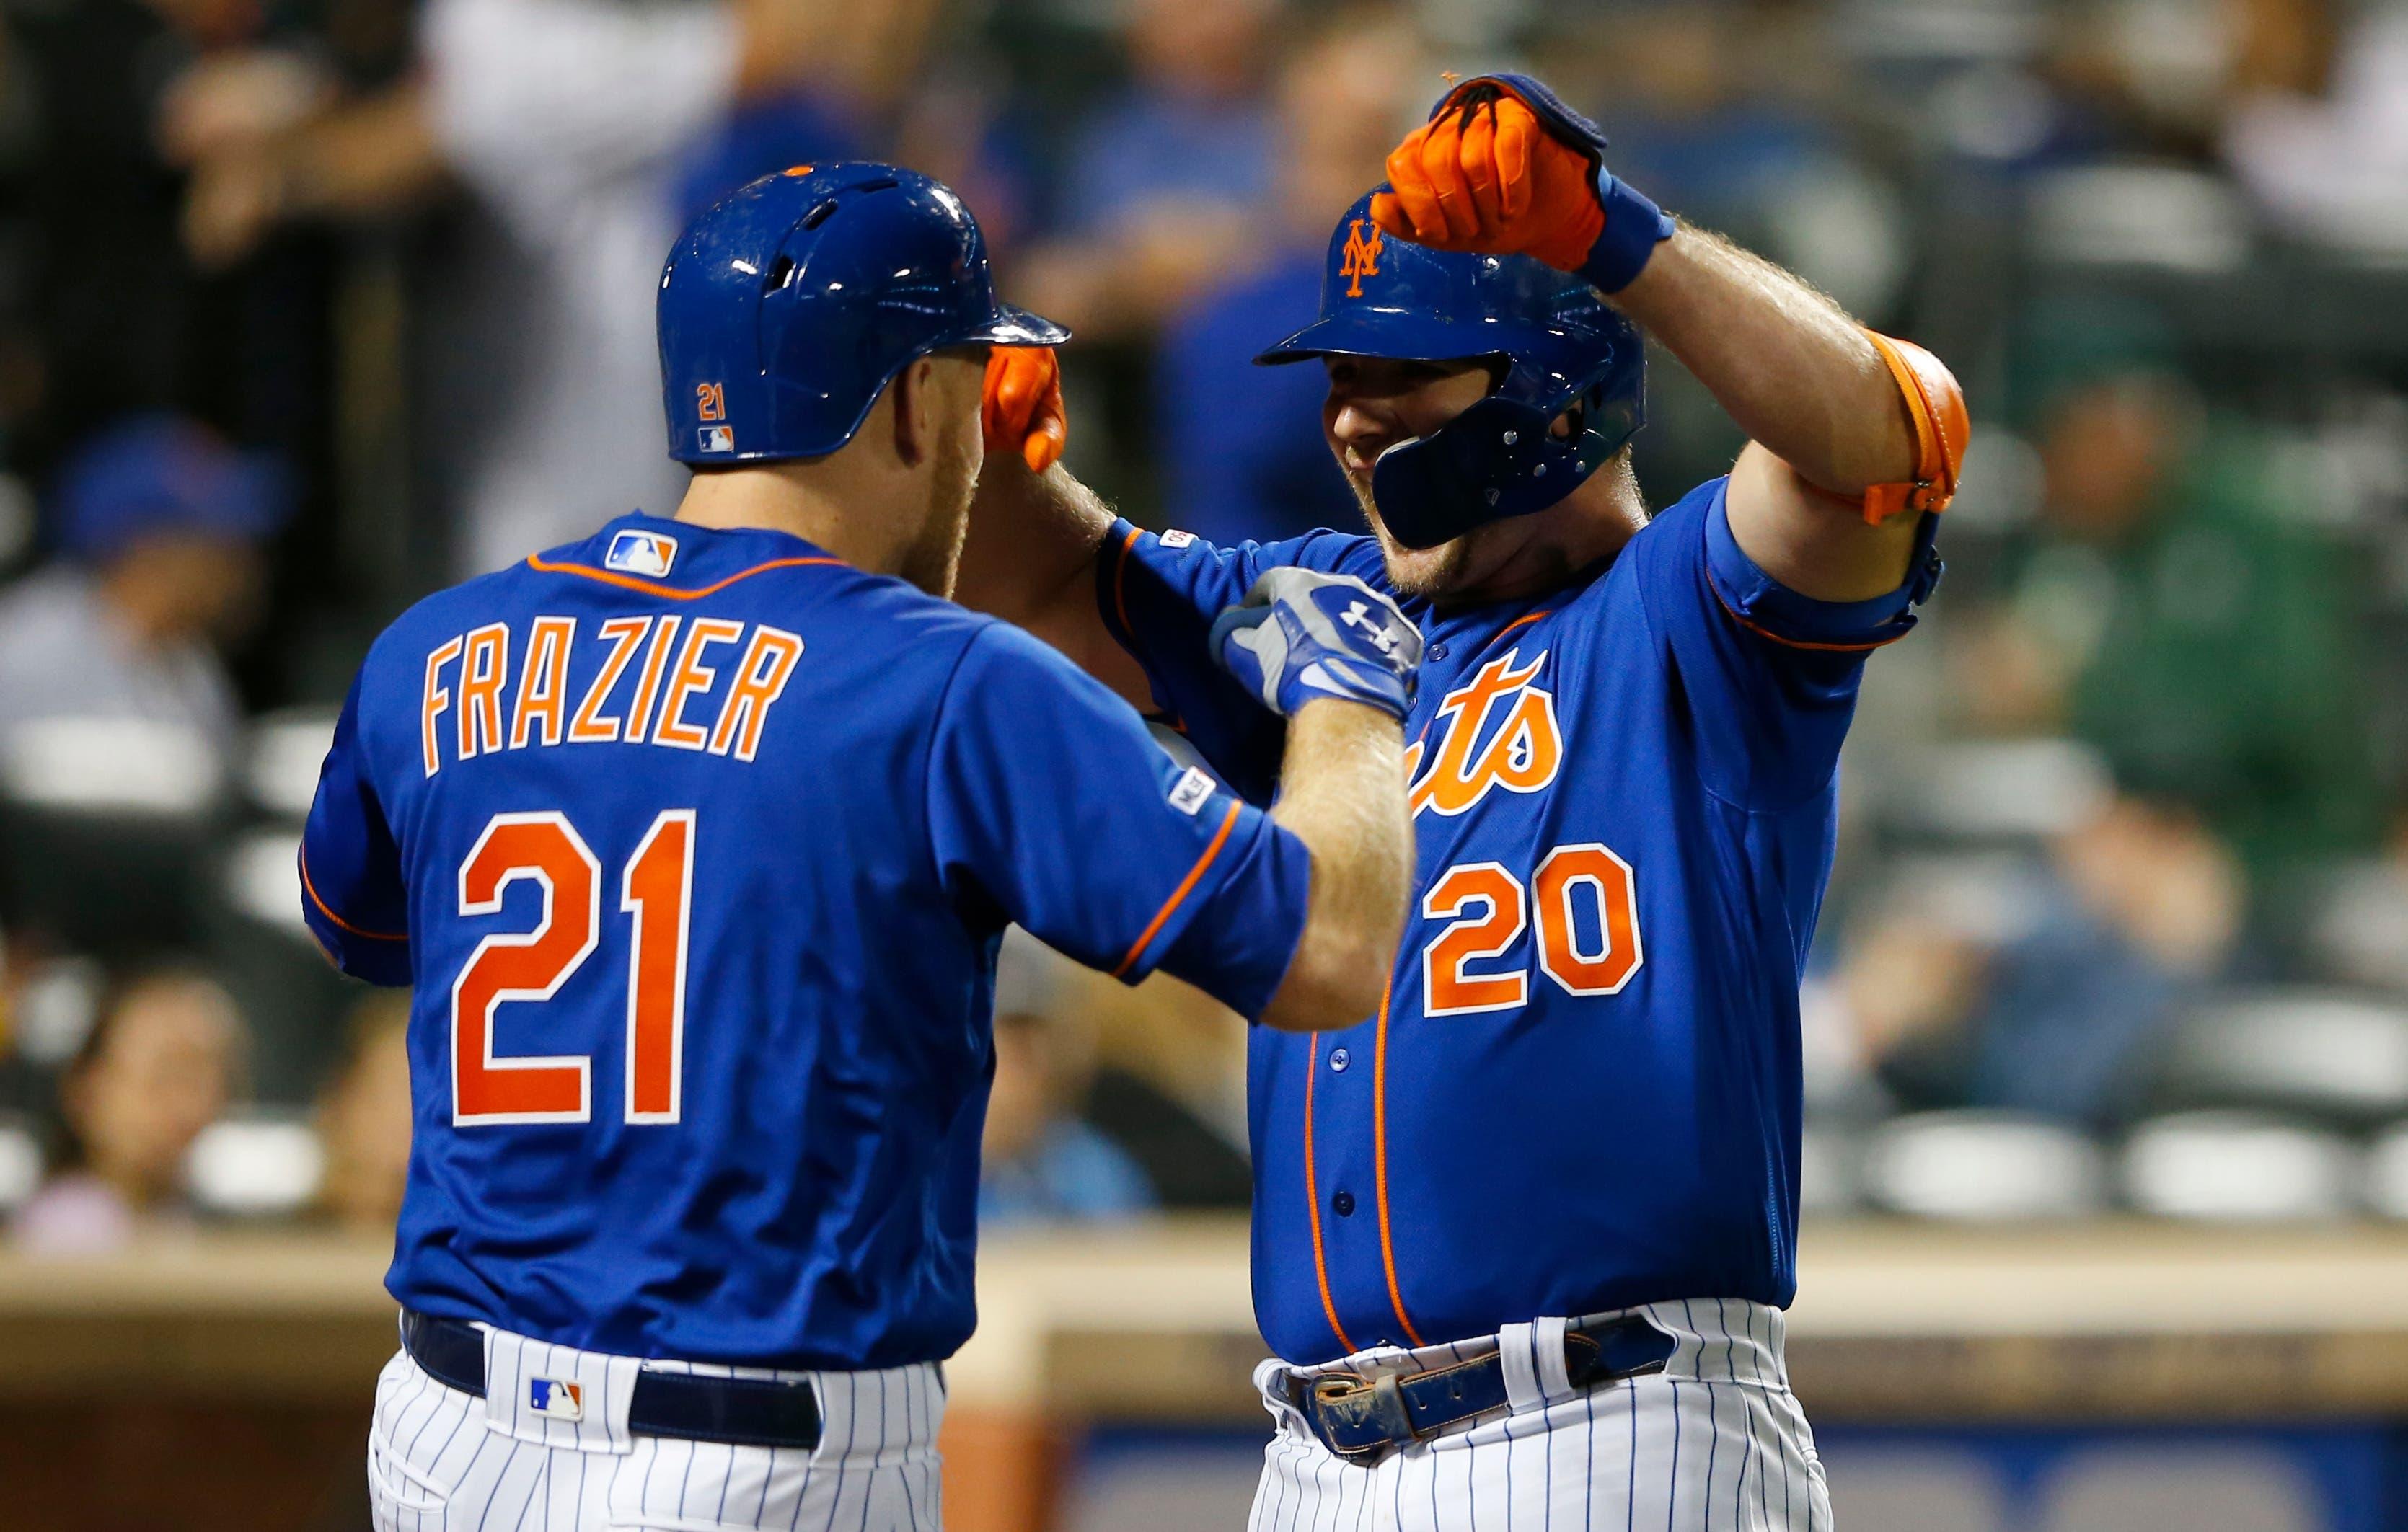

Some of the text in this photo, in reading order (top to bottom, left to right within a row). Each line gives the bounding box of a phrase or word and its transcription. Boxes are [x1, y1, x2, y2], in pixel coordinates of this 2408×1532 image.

[697, 382, 726, 421] 21
[421, 614, 805, 779] FRAZIER
[1405, 647, 1564, 820] ts
[451, 808, 697, 1128] 21
[1422, 842, 1644, 1018] 20
